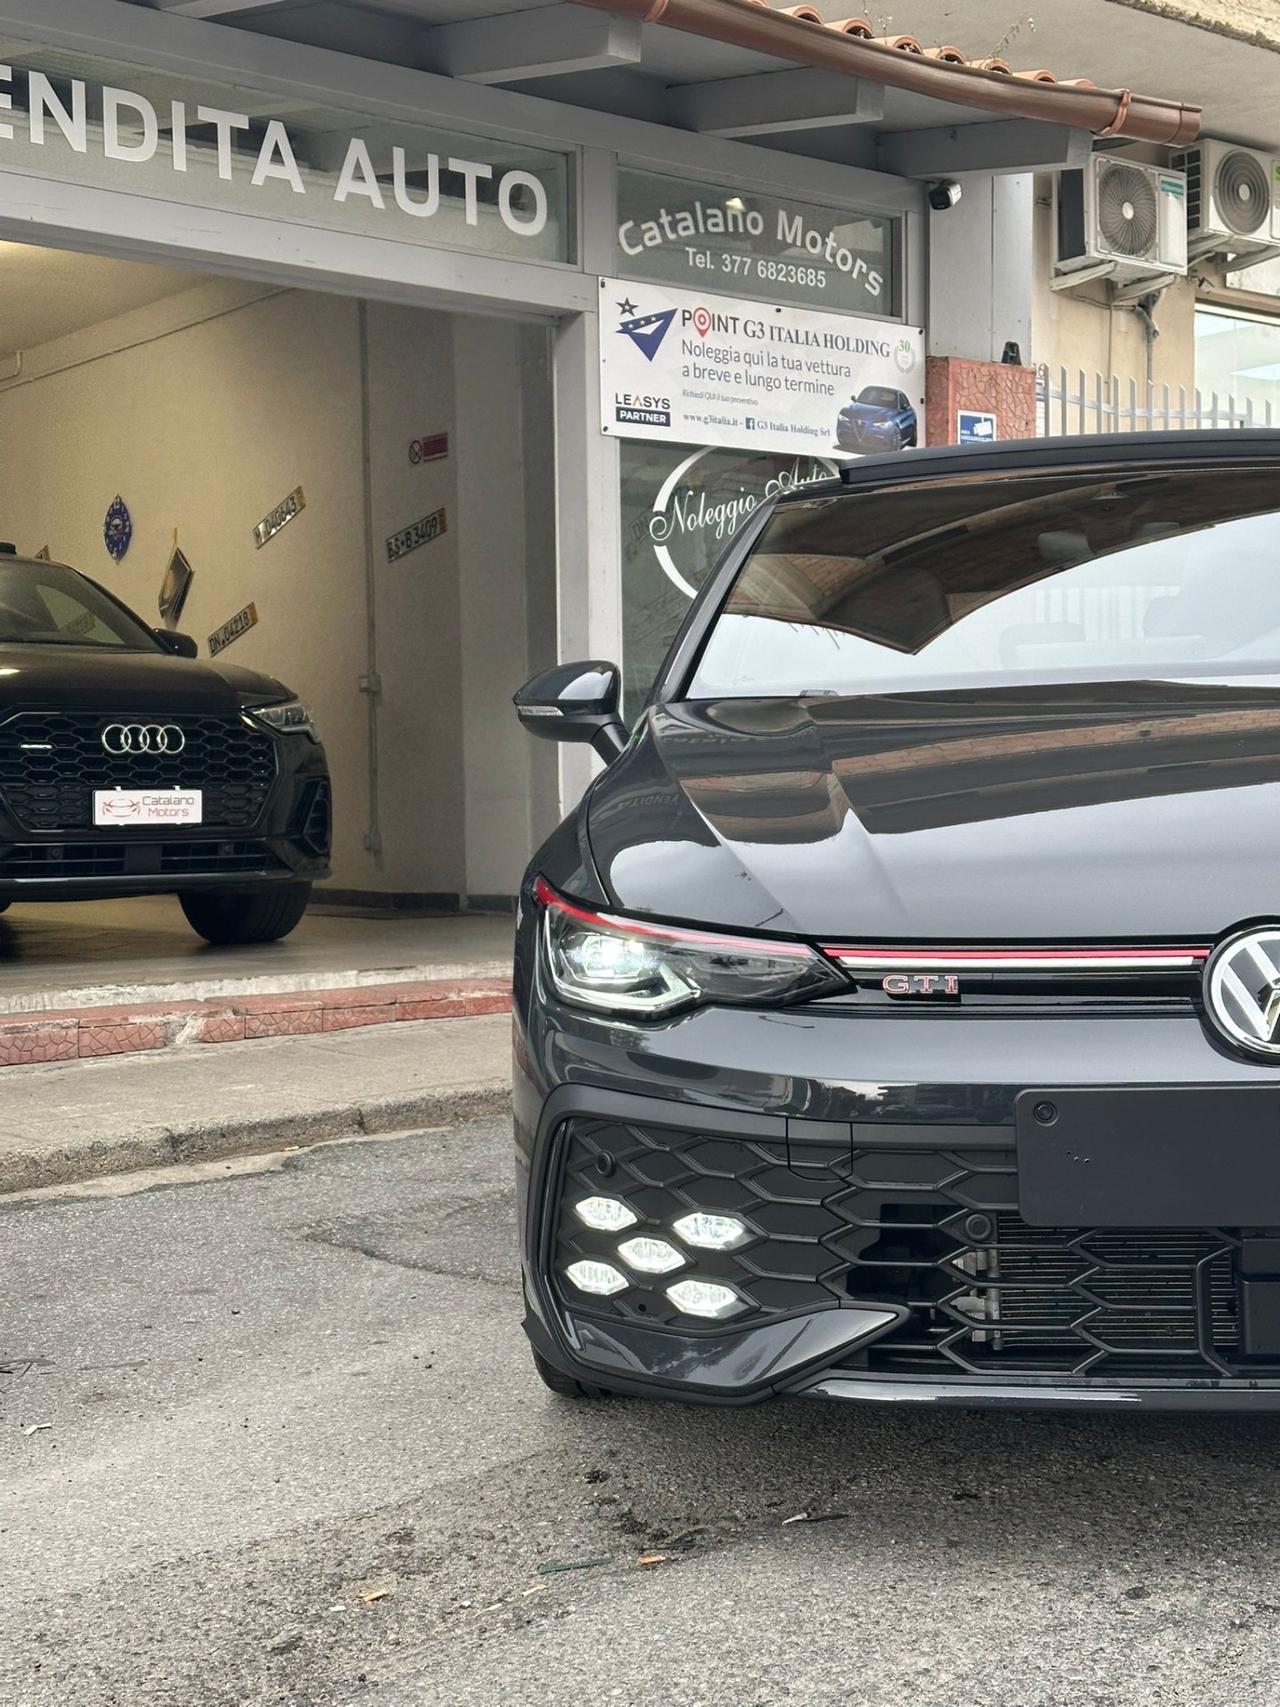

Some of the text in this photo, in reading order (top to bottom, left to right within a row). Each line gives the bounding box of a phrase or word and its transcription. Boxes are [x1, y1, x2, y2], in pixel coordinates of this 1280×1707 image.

[0, 65, 548, 236] NDITA AUTO
[618, 201, 883, 296] Catalano Motors
[685, 247, 826, 288] Tel. 377 6823685
[682, 307, 890, 357] POINT G3 ITALIA HOLDING
[682, 339, 851, 377] Noleggia qui la tua vettura
[682, 363, 835, 396] a breve e lungo termine
[615, 393, 671, 410] LEASYS
[620, 410, 667, 423] PARTNER
[769, 421, 789, 432] Italia
[790, 423, 819, 437] Holding
[649, 486, 756, 541] Noleggio
[142, 795, 195, 806] Catalano
[148, 808, 189, 817] Motors
[882, 974, 959, 994] GTI
